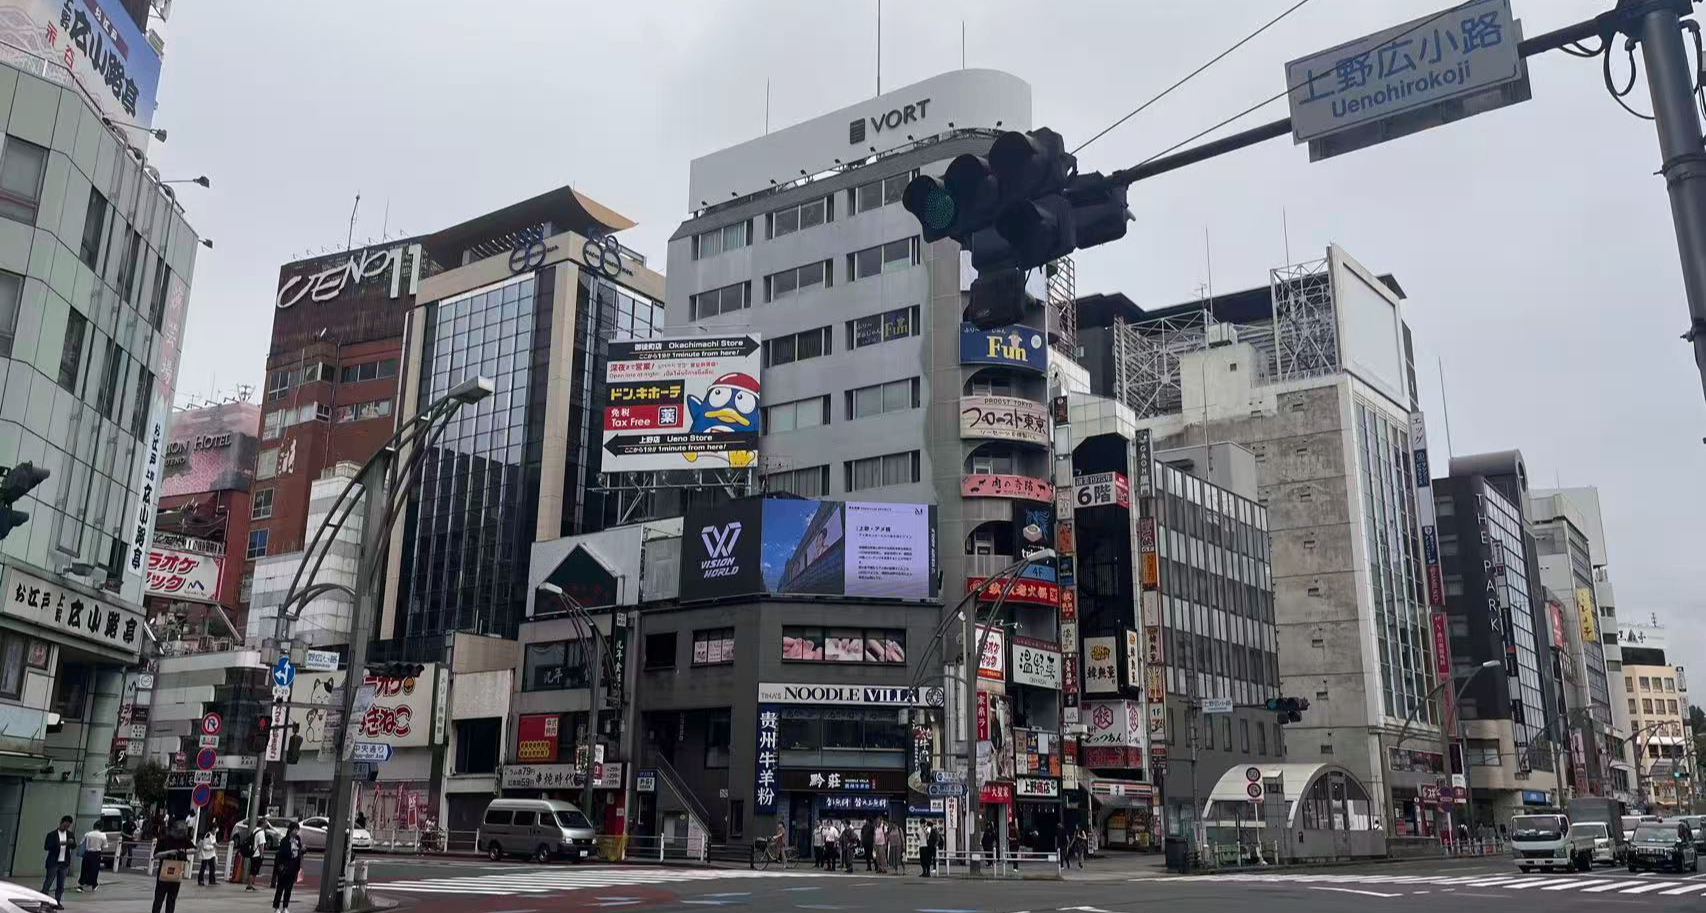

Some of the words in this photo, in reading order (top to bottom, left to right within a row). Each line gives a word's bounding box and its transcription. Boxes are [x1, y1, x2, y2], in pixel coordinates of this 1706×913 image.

[1299, 11, 1502, 105] 上野広小路
[1332, 60, 1471, 118] Uenohirokoji
[870, 98, 930, 133] VORT
[276, 249, 389, 308] UENO
[668, 340, 719, 349] Okachimachi
[721, 339, 744, 347] Store
[987, 335, 1028, 362] Fun
[1014, 400, 1033, 408] TOKYO
[611, 418, 627, 427] Tax
[630, 417, 651, 426] Free
[660, 408, 675, 424] 薬
[1412, 416, 1423, 445] エッグ
[193, 432, 232, 452] HOTEL
[1077, 484, 1111, 505] 6階
[148, 551, 199, 574] ラオケ
[701, 557, 736, 570] VISION
[703, 565, 740, 579] WORLD
[1032, 566, 1043, 577] 4F
[1475, 493, 1489, 545] THE
[1483, 559, 1500, 633] PARK
[145, 571, 187, 593] ック
[784, 686, 860, 701] NOODLE
[865, 687, 917, 702] VILLA
[757, 711, 777, 806] 贵州牛羊粉
[1023, 780, 1051, 794] 上野商店
